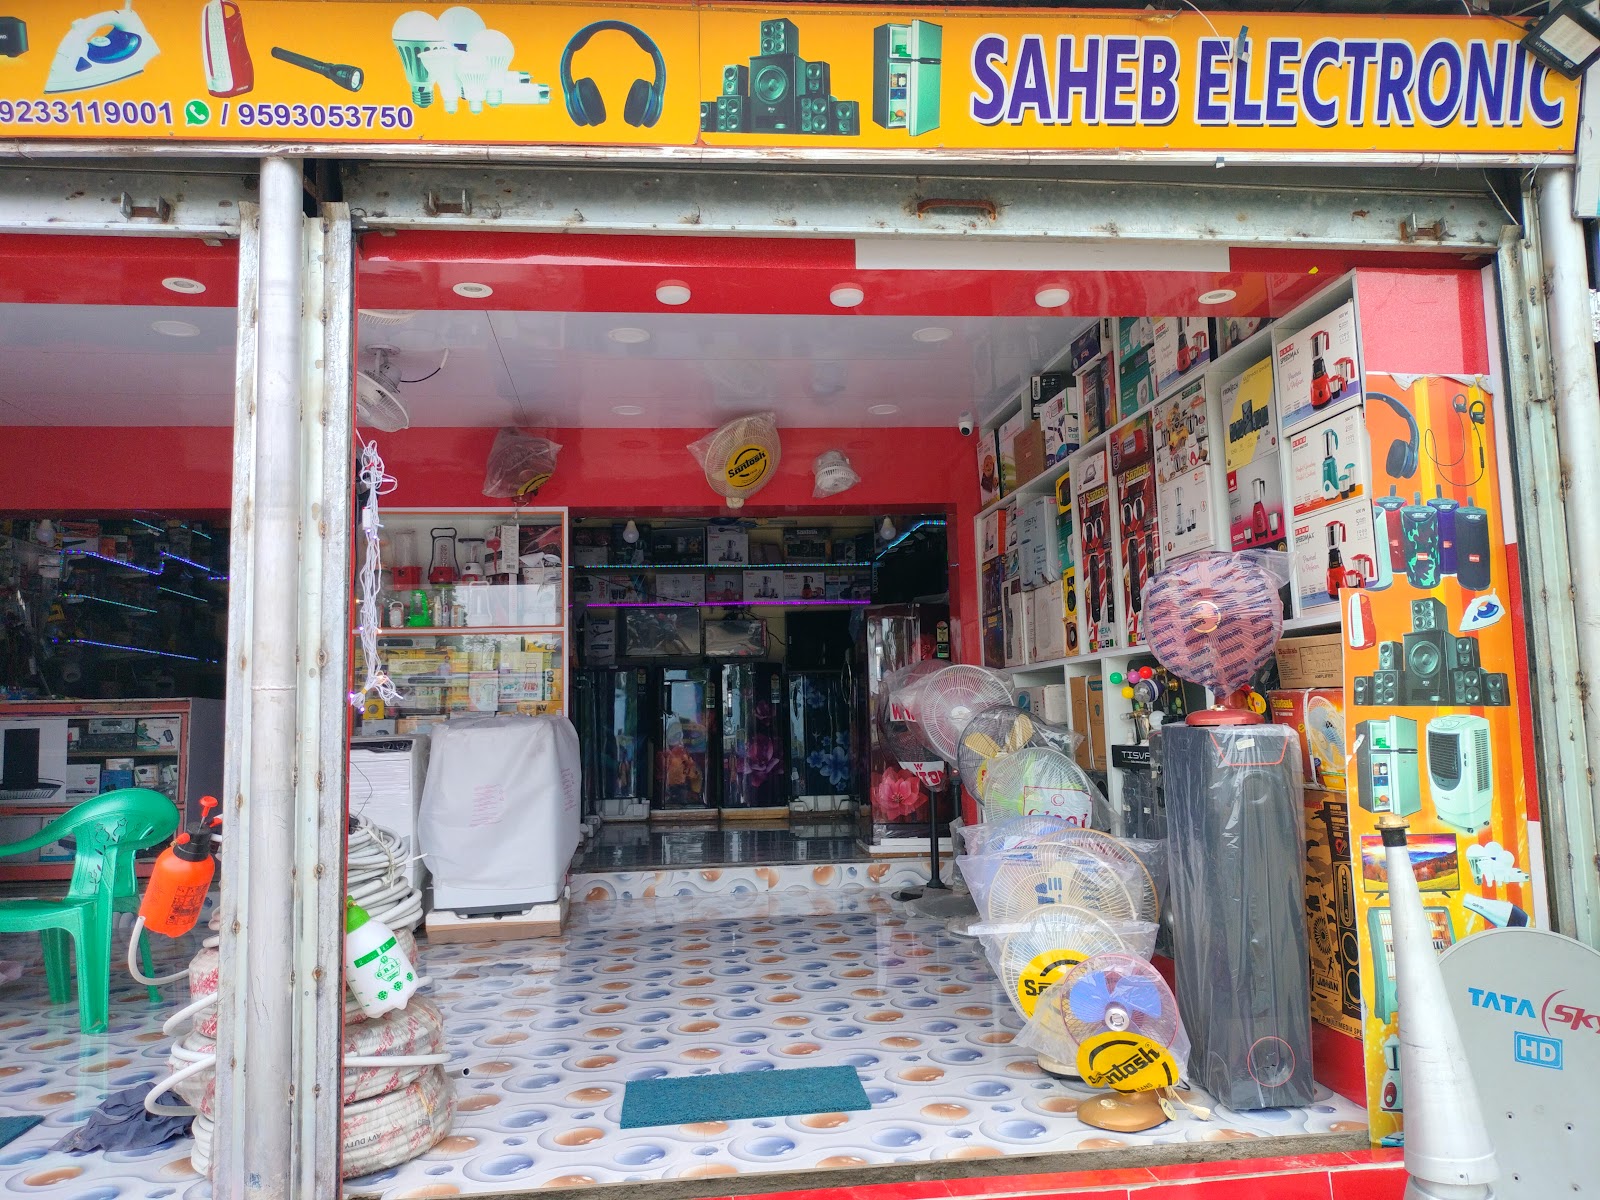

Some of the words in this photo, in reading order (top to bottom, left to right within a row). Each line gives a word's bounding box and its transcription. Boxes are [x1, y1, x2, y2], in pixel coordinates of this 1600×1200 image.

[971, 36, 1179, 126] SAHEB
[1194, 37, 1565, 128] ELECTRONIC
[0, 100, 173, 125] 9233119001
[238, 103, 414, 128] 9593053750
[727, 450, 767, 479] Santosh
[1468, 987, 1536, 1018] TATA
[1520, 1038, 1557, 1062] HD
[1088, 1047, 1161, 1085] Sntosh
